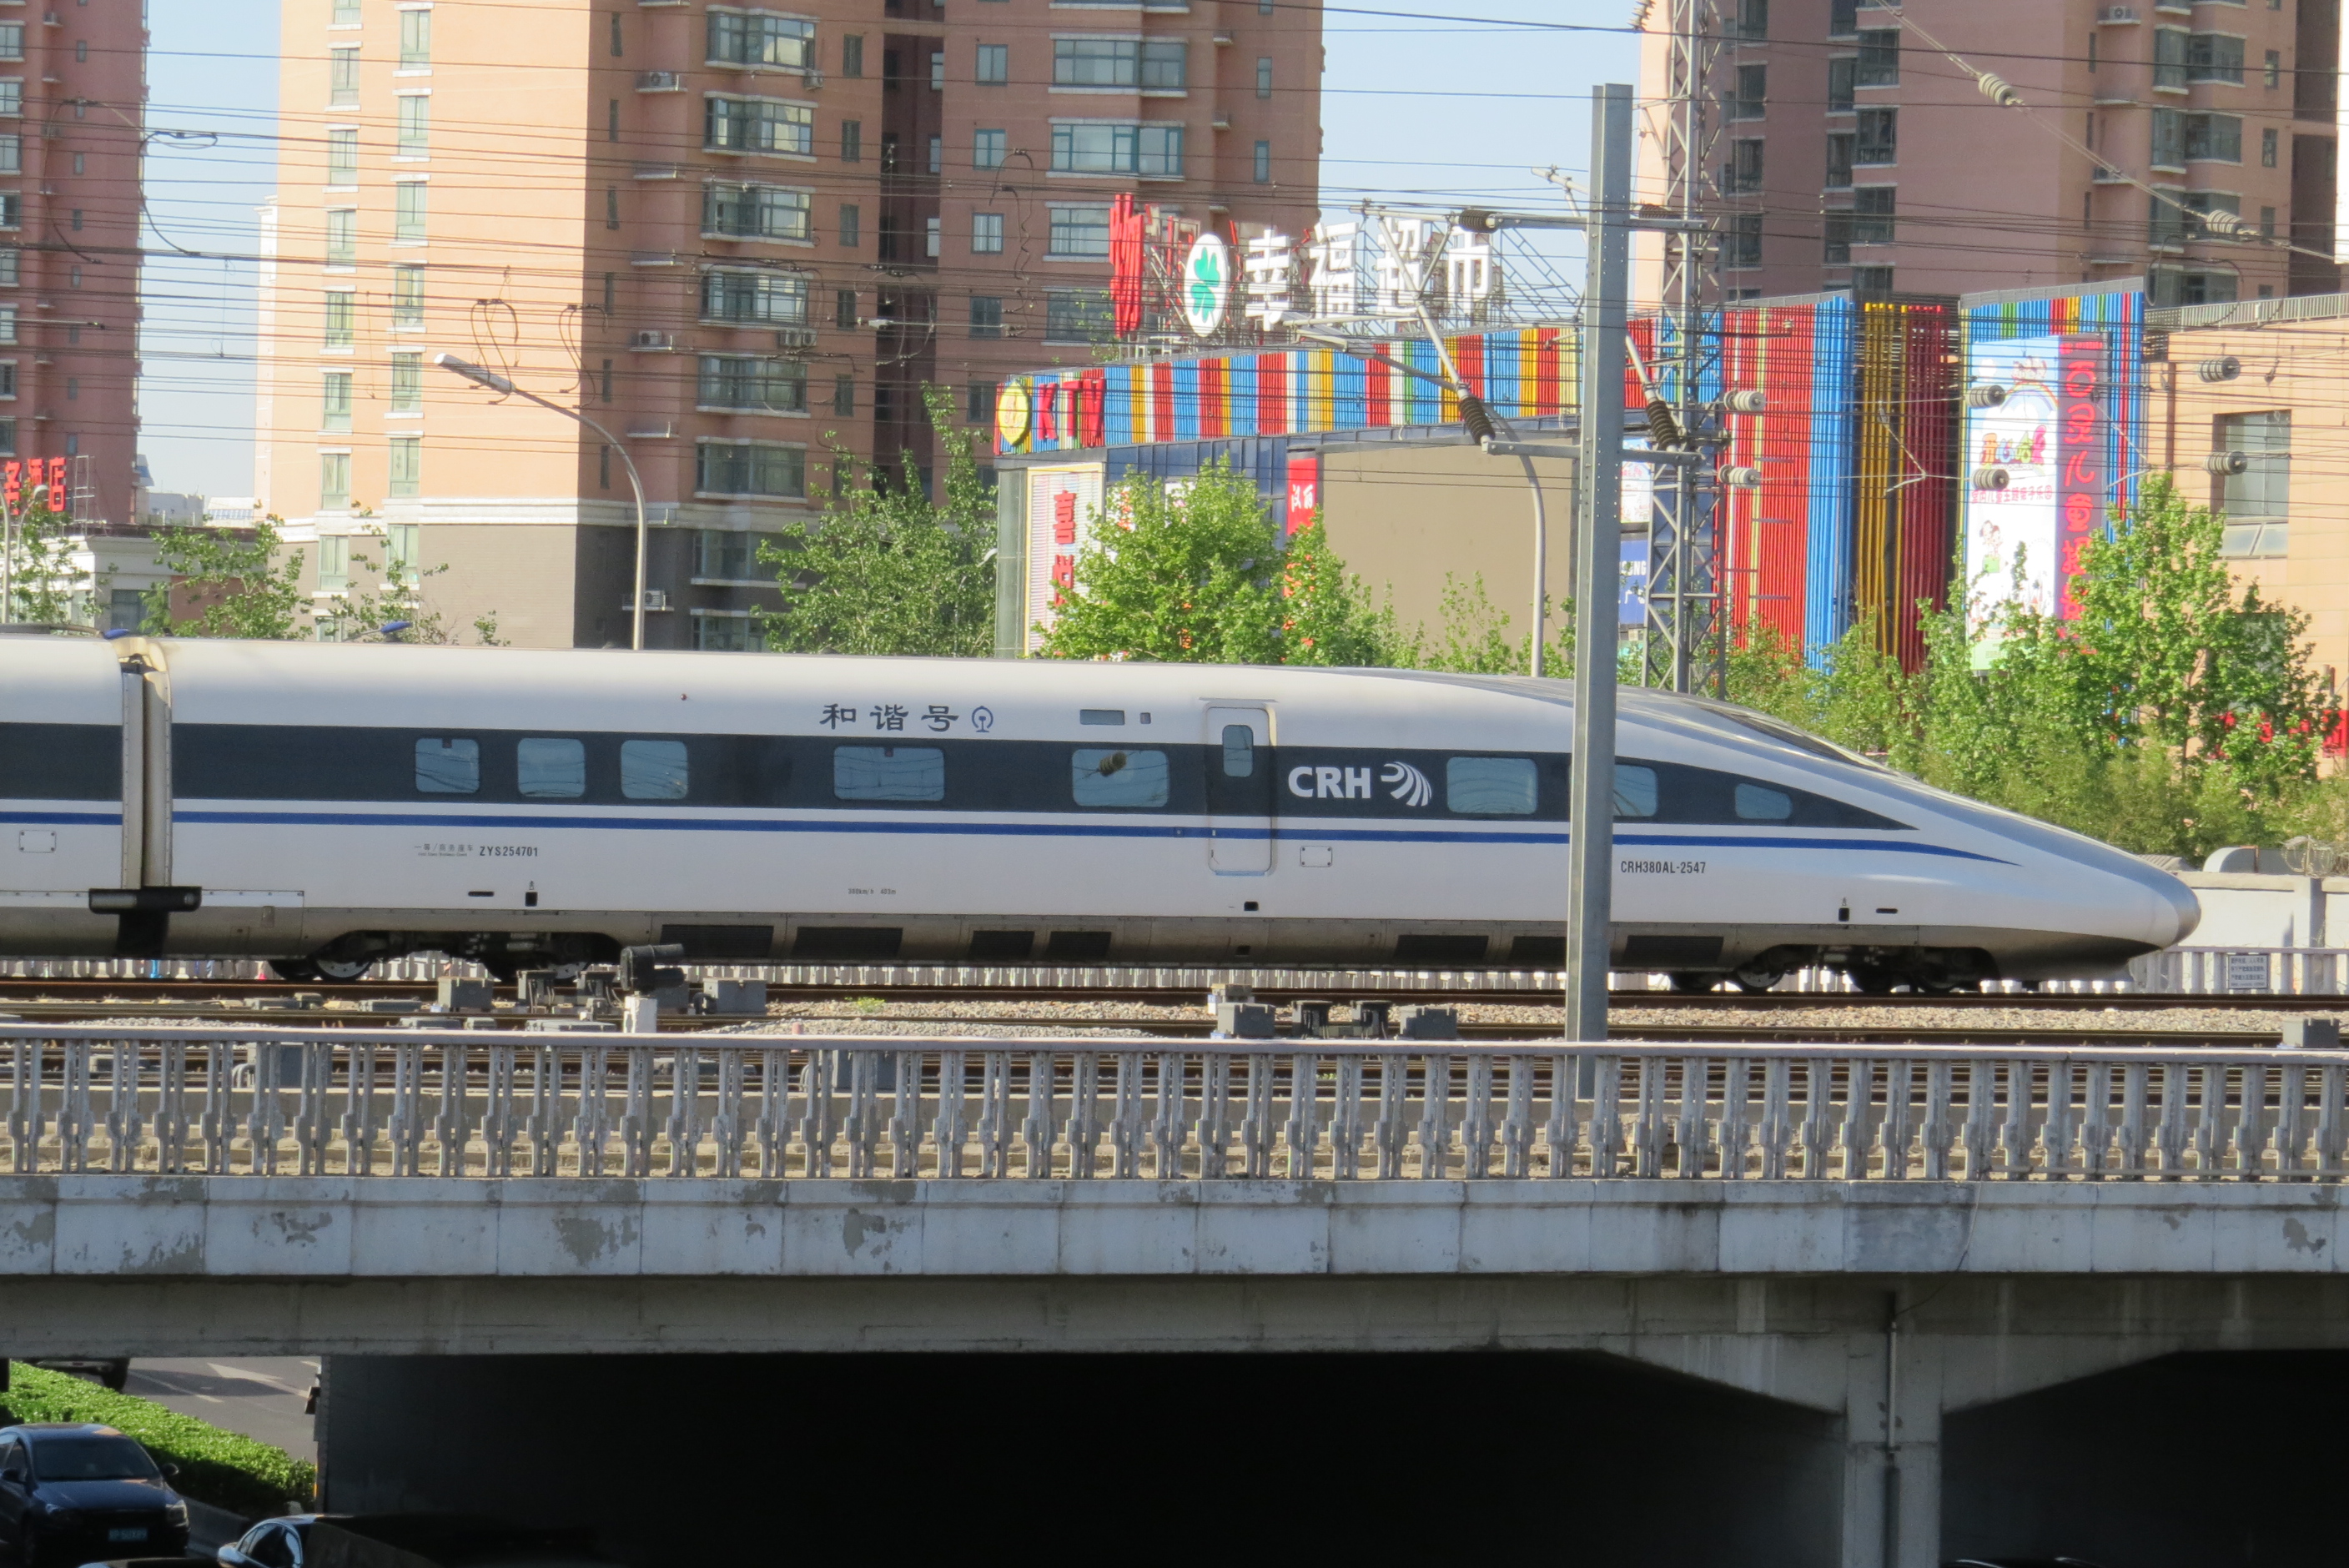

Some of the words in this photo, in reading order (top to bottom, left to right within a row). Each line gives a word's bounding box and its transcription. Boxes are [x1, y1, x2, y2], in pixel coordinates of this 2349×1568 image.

[1245, 214, 1493, 332] 幸福超市
[1038, 379, 1105, 440] KTV
[1619, 560, 1647, 575] SUNG
[819, 703, 959, 732] 和谐号
[1288, 766, 1371, 799] CRH
[479, 846, 539, 857] ZYS254701
[1621, 861, 1707, 874] CRH380AL-2547
